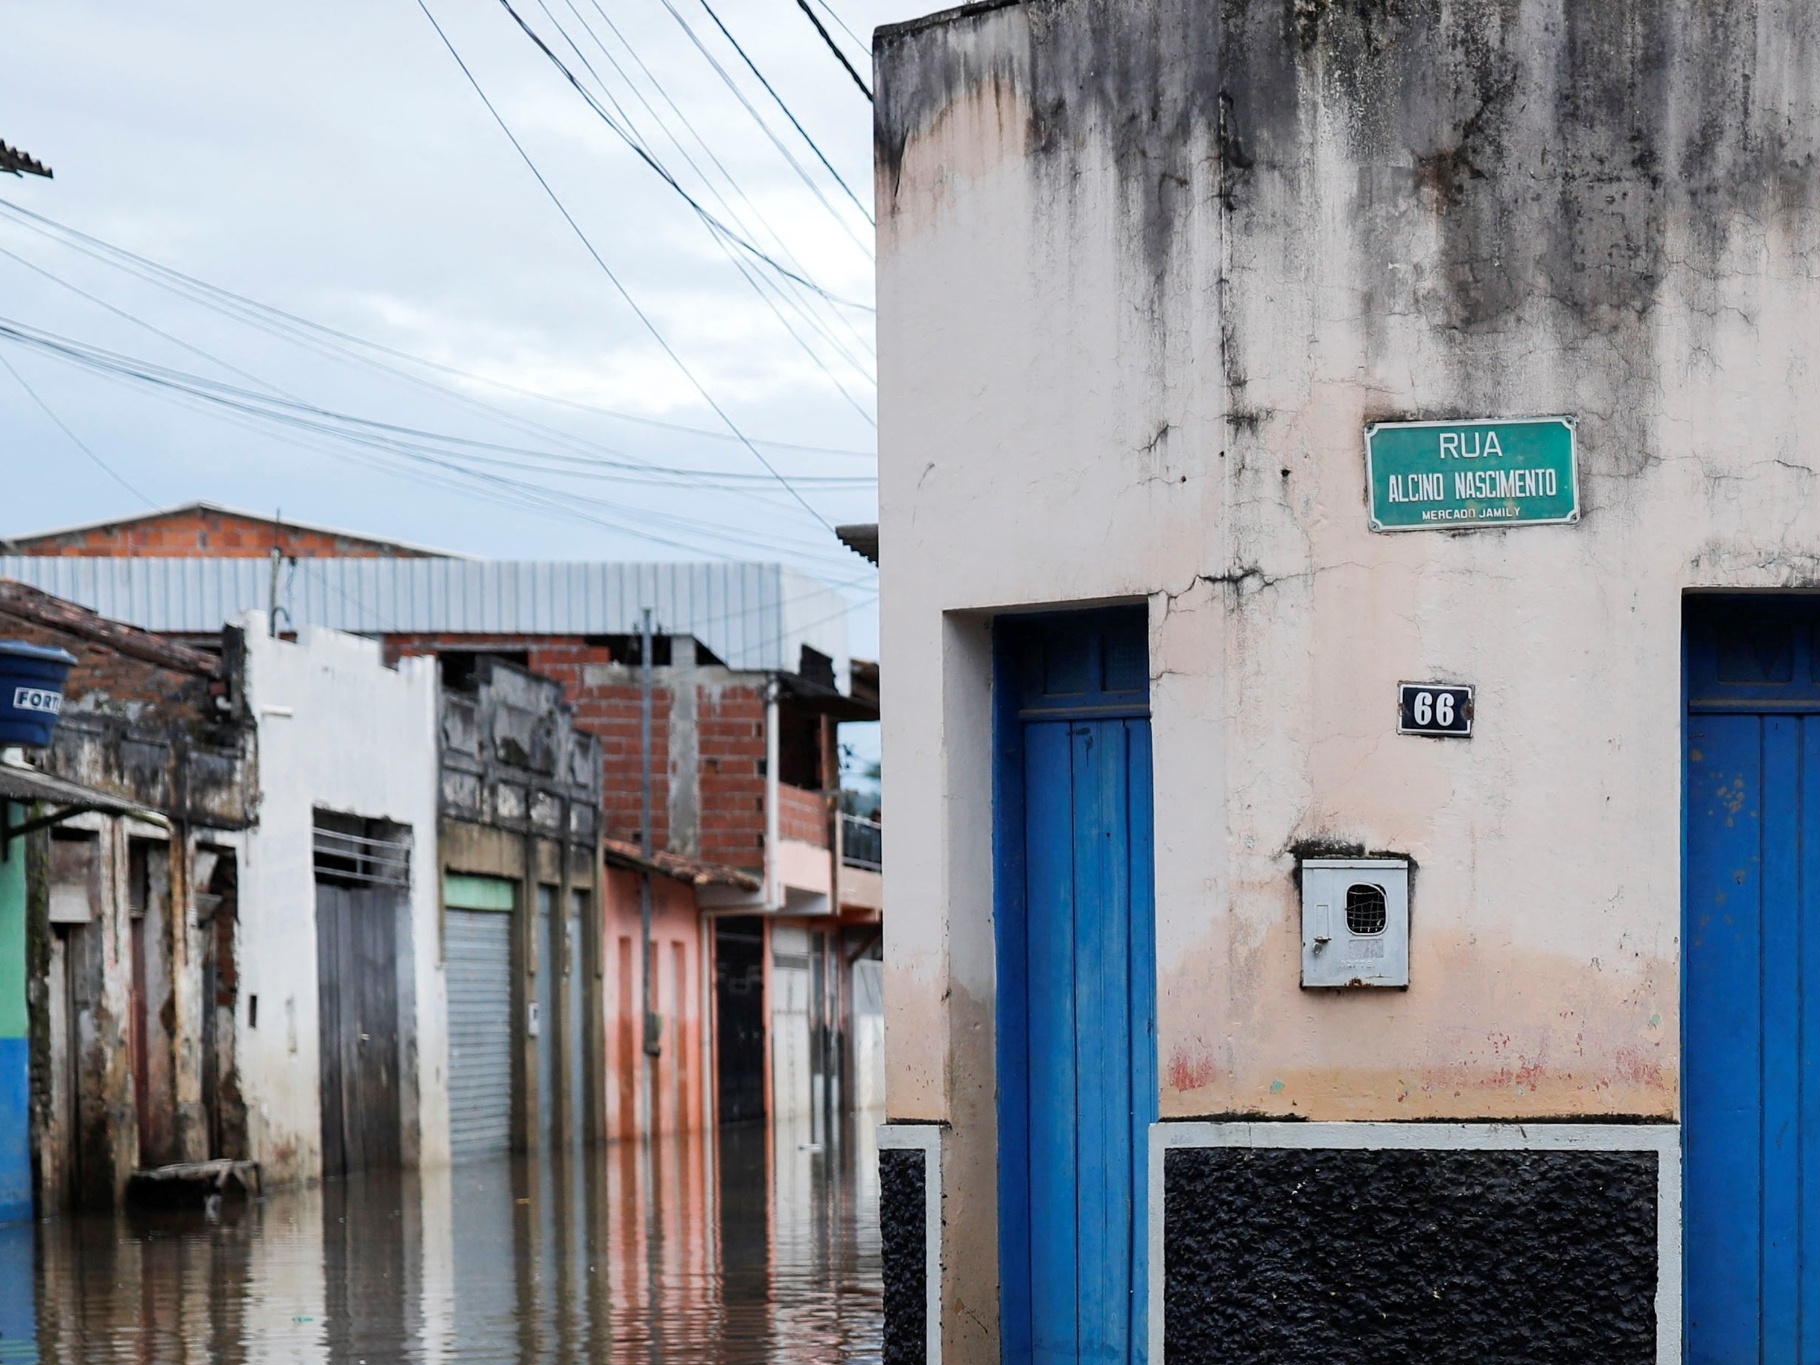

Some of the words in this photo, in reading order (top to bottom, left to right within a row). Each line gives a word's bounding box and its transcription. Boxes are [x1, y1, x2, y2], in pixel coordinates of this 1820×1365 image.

[1440, 431, 1503, 459] RUA
[1389, 473, 1444, 502] ALCINO
[1455, 468, 1557, 499] NASCIMENTO
[1422, 508, 1476, 520] MERCADO
[1479, 506, 1521, 518] JAMILY
[1414, 691, 1455, 727] 66
